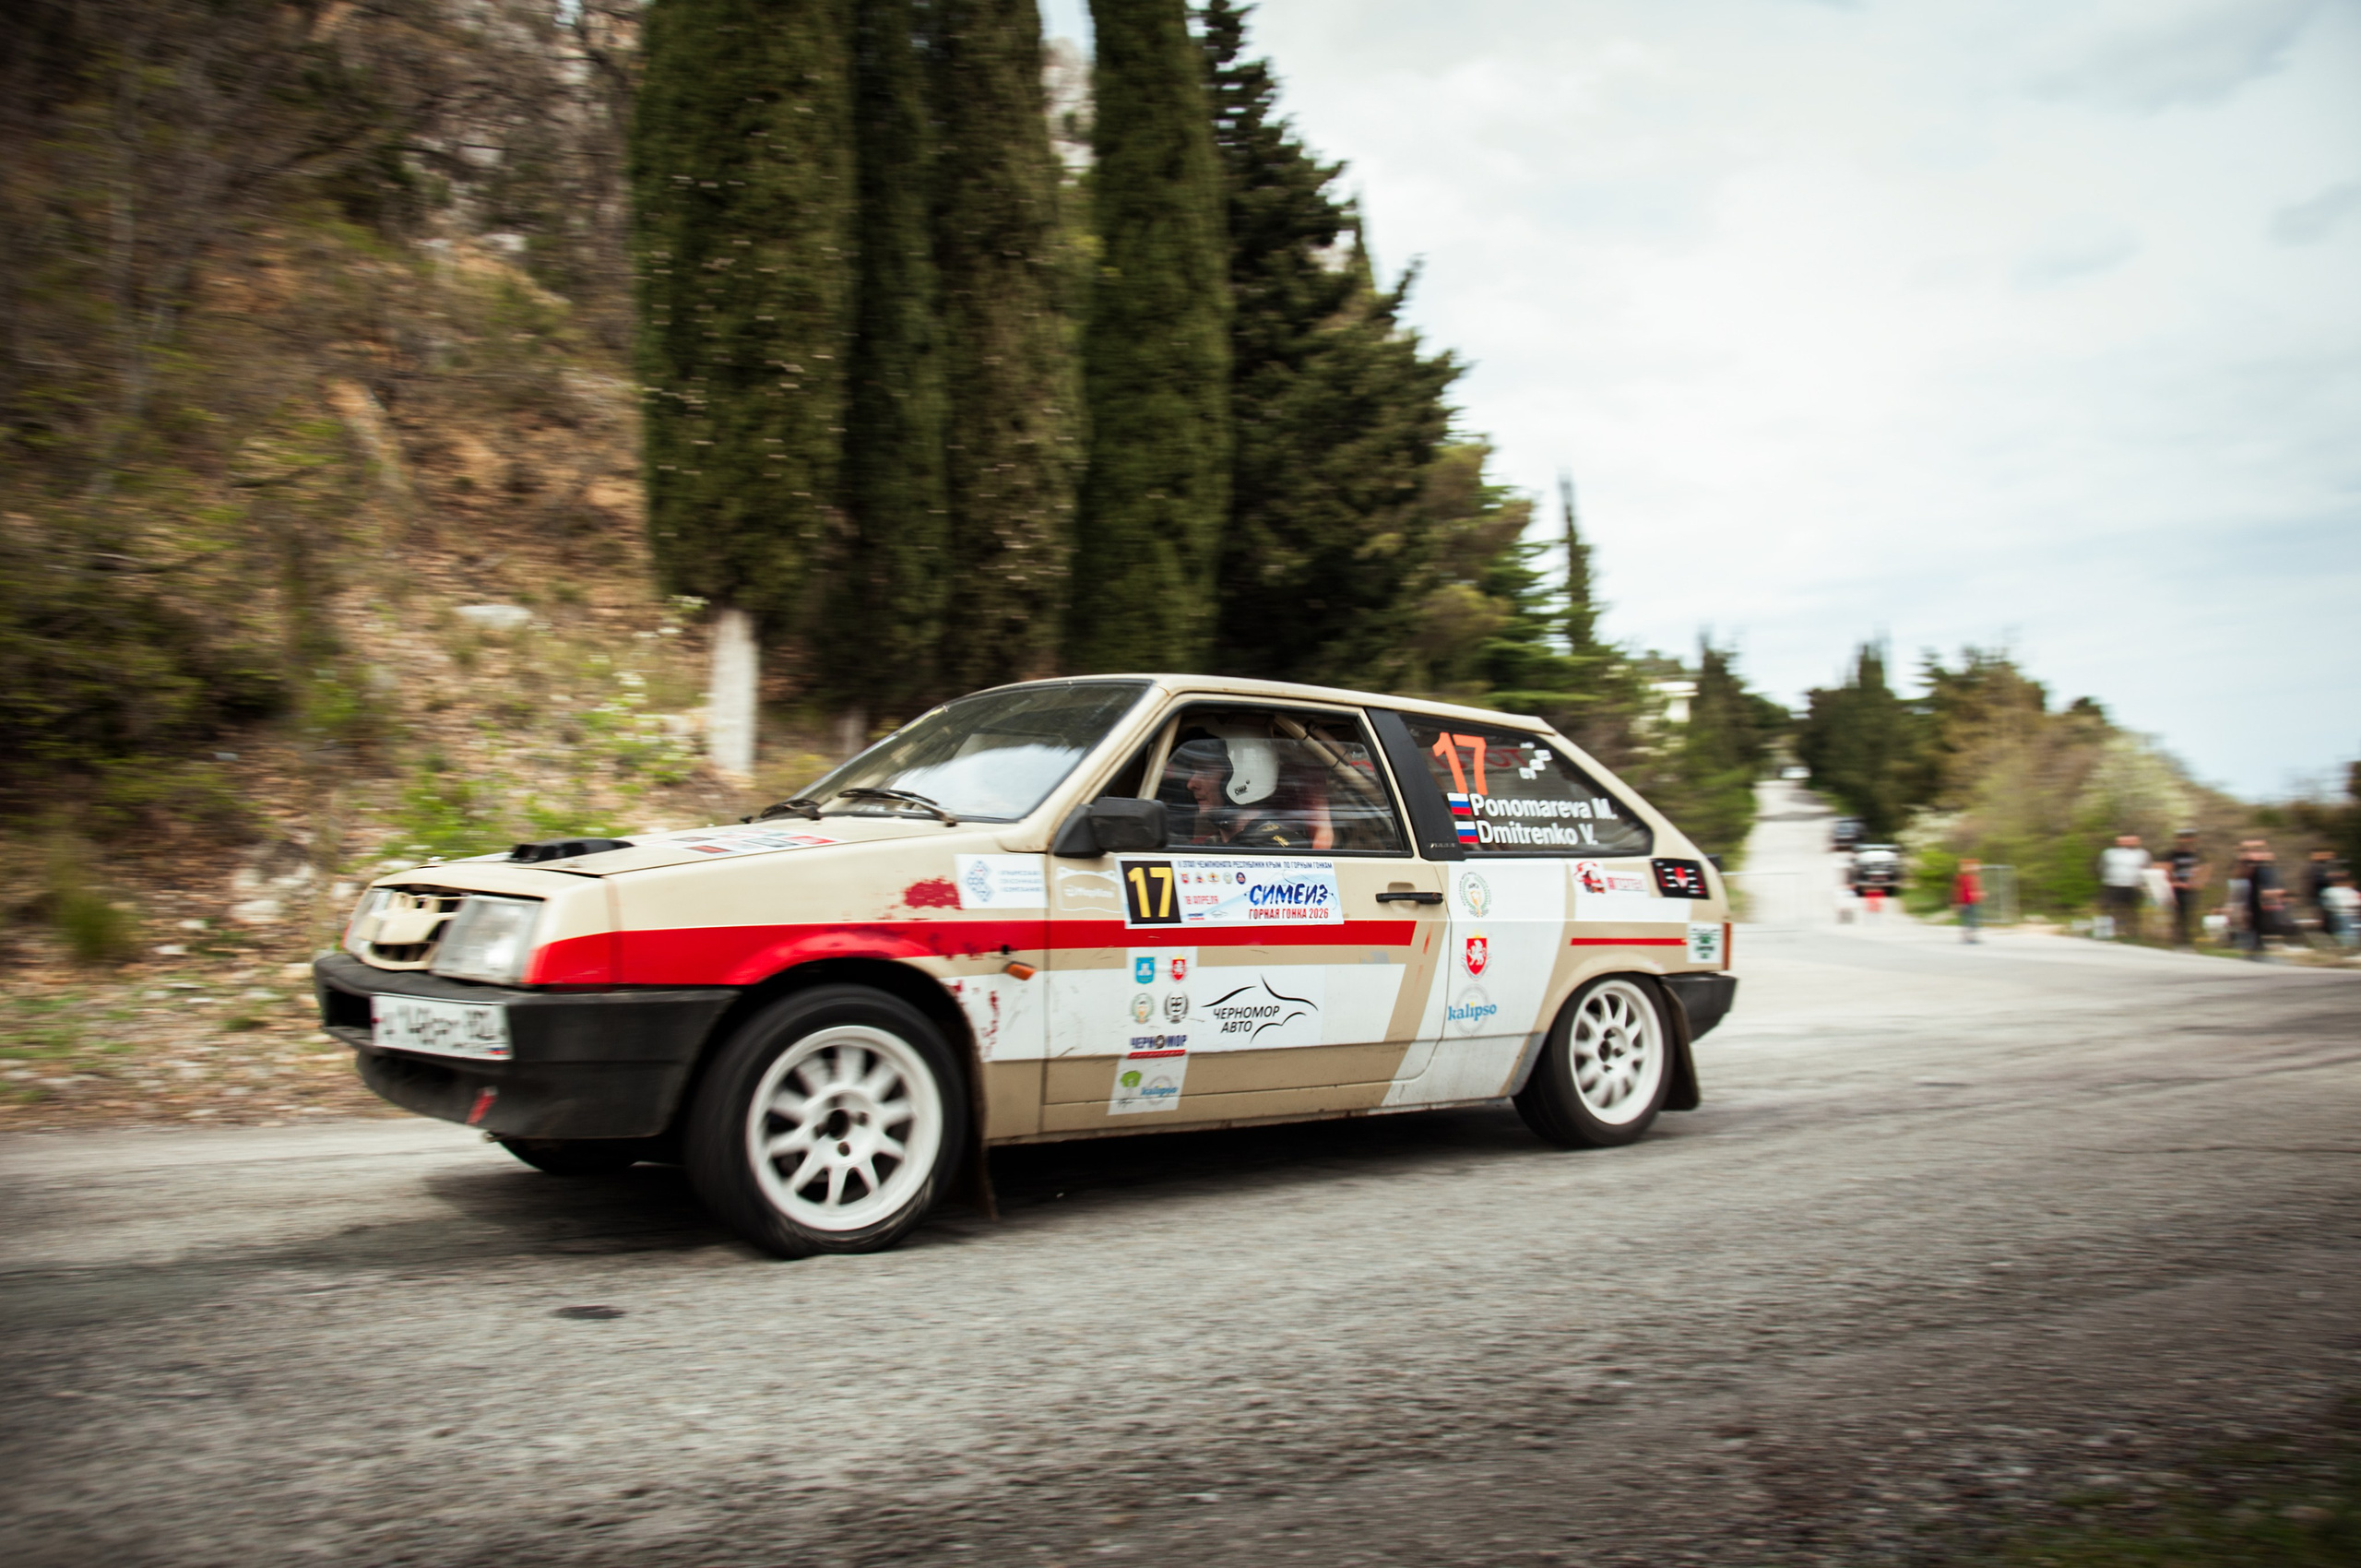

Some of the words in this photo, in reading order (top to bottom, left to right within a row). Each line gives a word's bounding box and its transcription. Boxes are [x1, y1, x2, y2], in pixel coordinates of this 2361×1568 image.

[1432, 731, 1488, 796] 17
[1469, 793, 1592, 819] Ponomareva
[1591, 798, 1618, 820] M.
[1477, 820, 1578, 846] Dmitrenko
[1578, 824, 1598, 846] V.
[1266, 861, 1282, 869] КРЫМ
[1291, 861, 1312, 869] ГОРНЫМ
[1127, 866, 1173, 918] 17
[1249, 883, 1328, 906] СИМЕИЗ
[1249, 909, 1280, 920] ГОРНАЯ
[1282, 908, 1307, 919] ГОНКА
[1309, 908, 1329, 919] 2026
[1213, 1005, 1280, 1020] ЧЕРНОМОР
[1448, 1002, 1497, 1021] kalipso
[1220, 1020, 1252, 1033] АВТО
